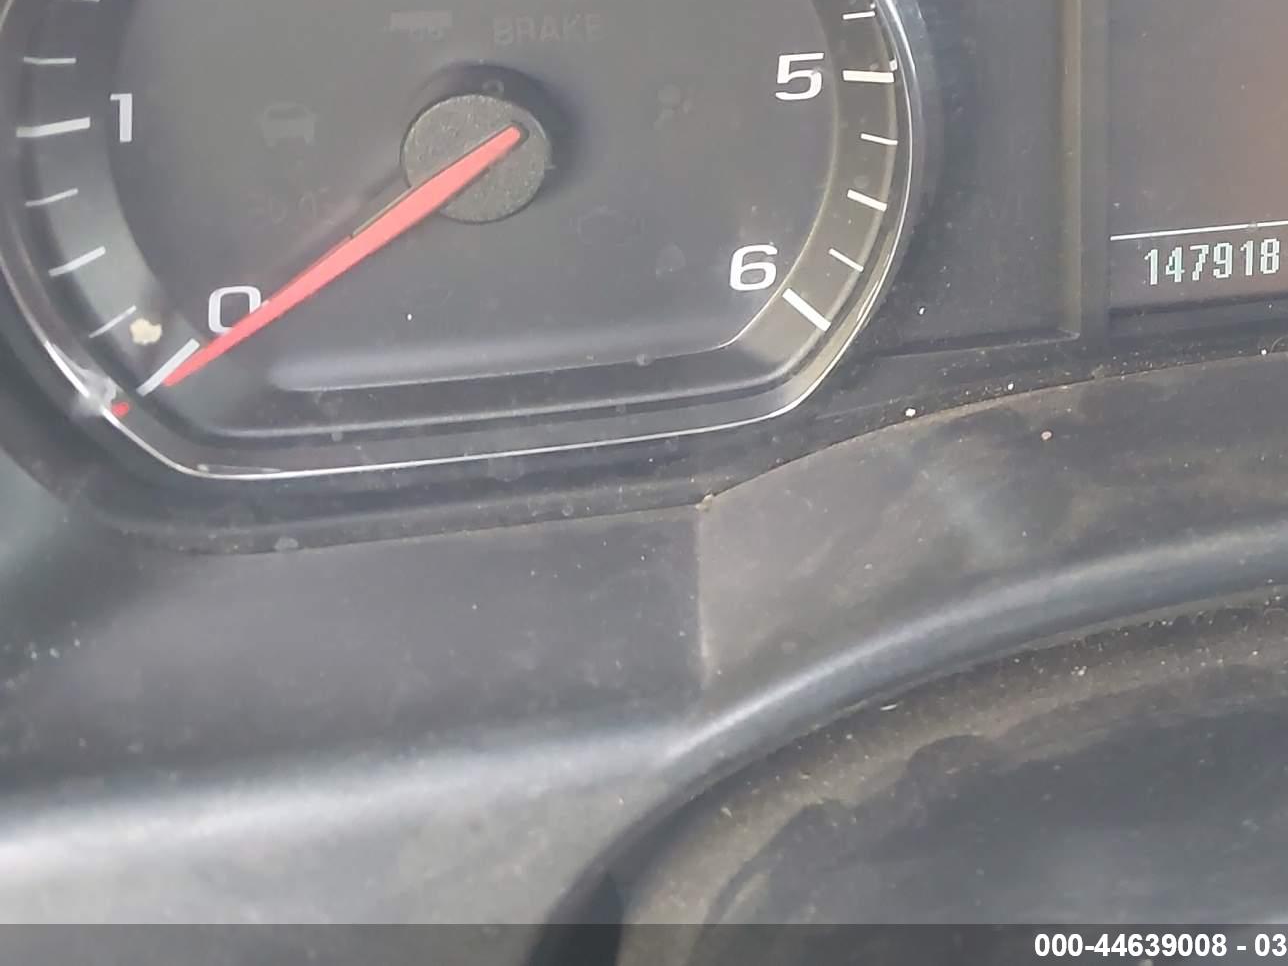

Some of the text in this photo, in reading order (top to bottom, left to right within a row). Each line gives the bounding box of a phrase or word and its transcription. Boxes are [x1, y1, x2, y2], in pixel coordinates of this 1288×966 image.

[775, 52, 825, 101] 5
[110, 93, 133, 142] 1
[729, 244, 778, 291] 6
[1144, 238, 1280, 285] 147918
[207, 286, 262, 334] 0
